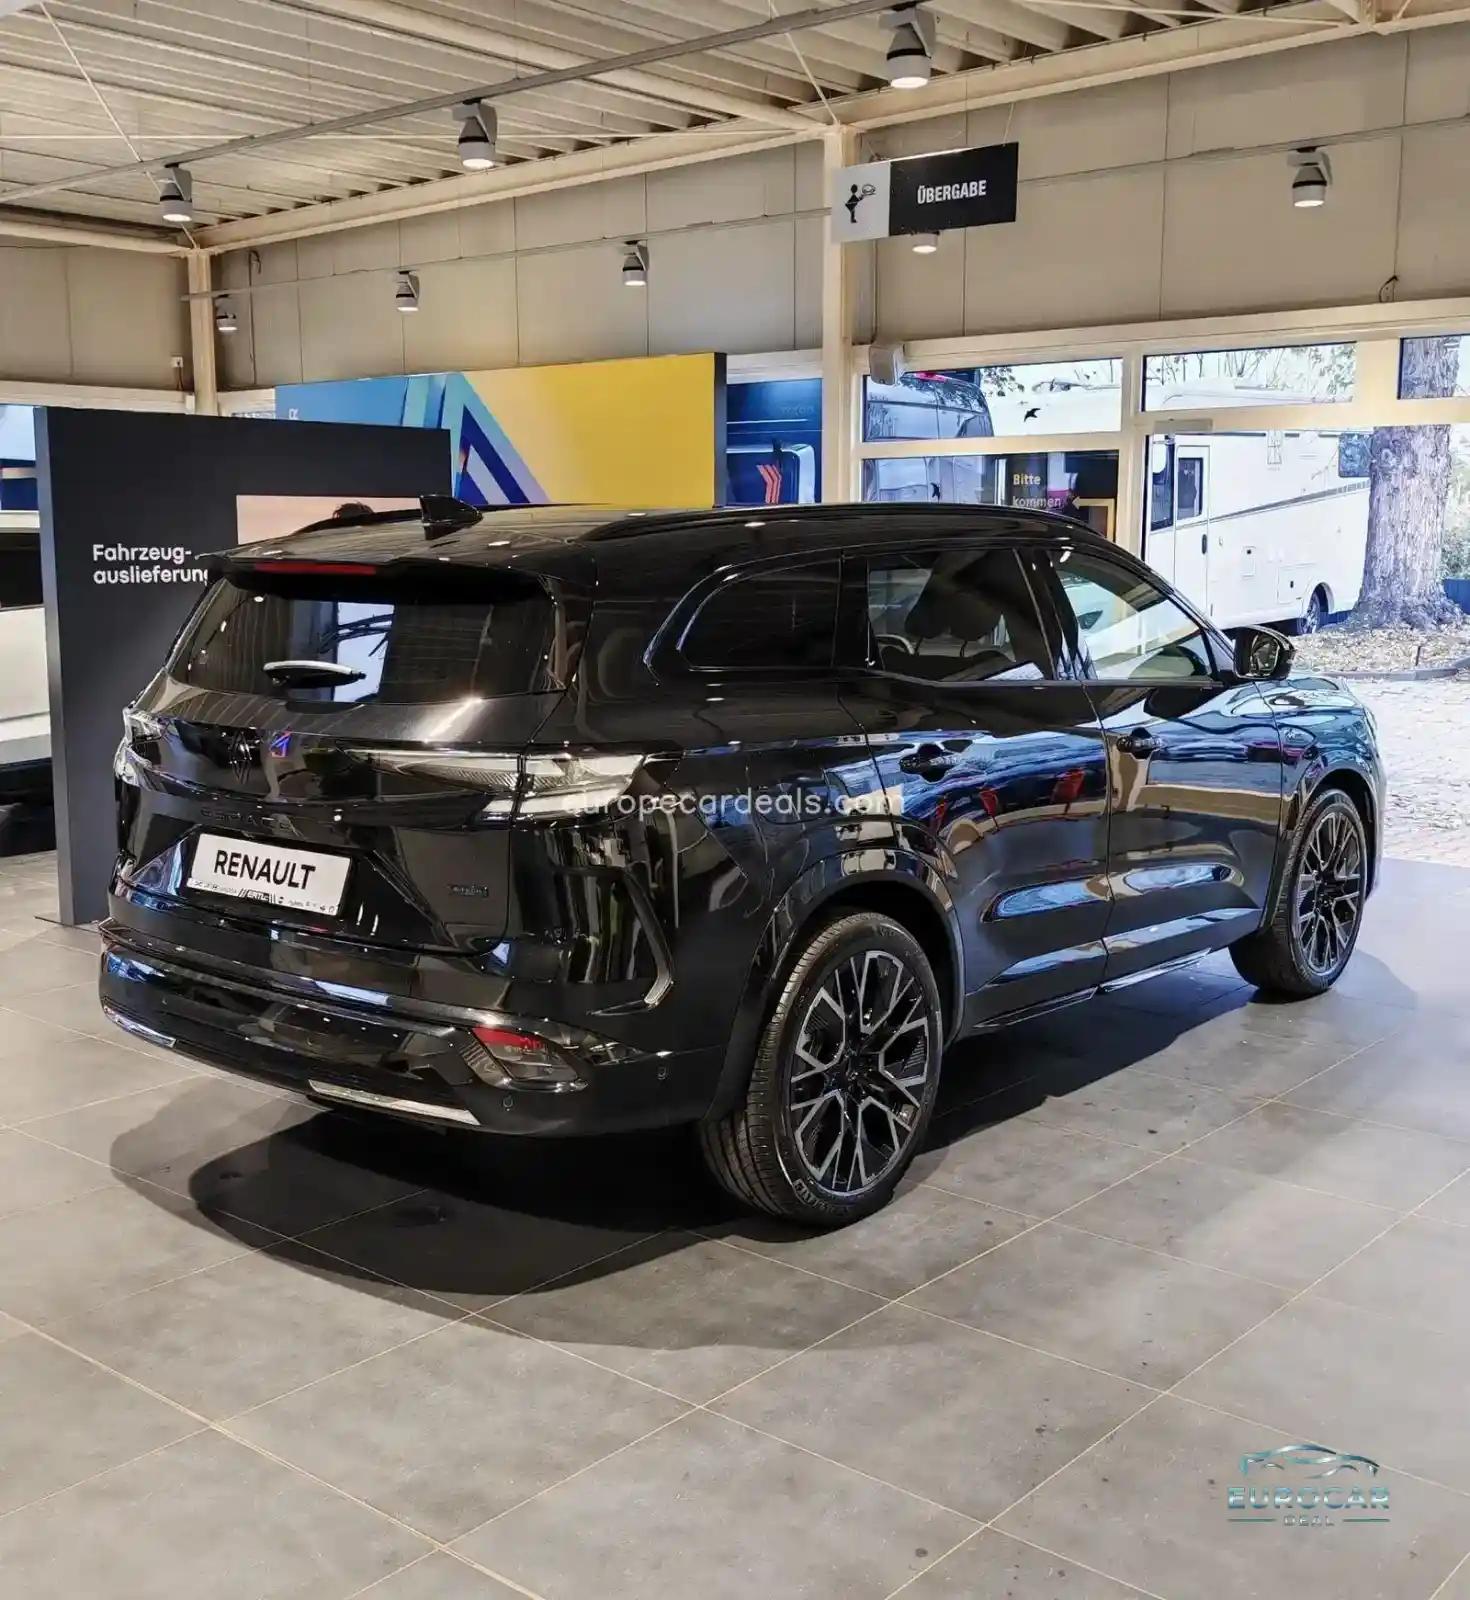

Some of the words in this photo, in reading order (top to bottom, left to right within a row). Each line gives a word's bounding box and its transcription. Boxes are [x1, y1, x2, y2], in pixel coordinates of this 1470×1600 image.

[917, 180, 987, 204] ÜBERGABE
[1013, 474, 1041, 485] Bitte
[1012, 495, 1062, 508] kommen
[92, 543, 192, 565] Fahrzeug-
[213, 850, 316, 890] RENAULT
